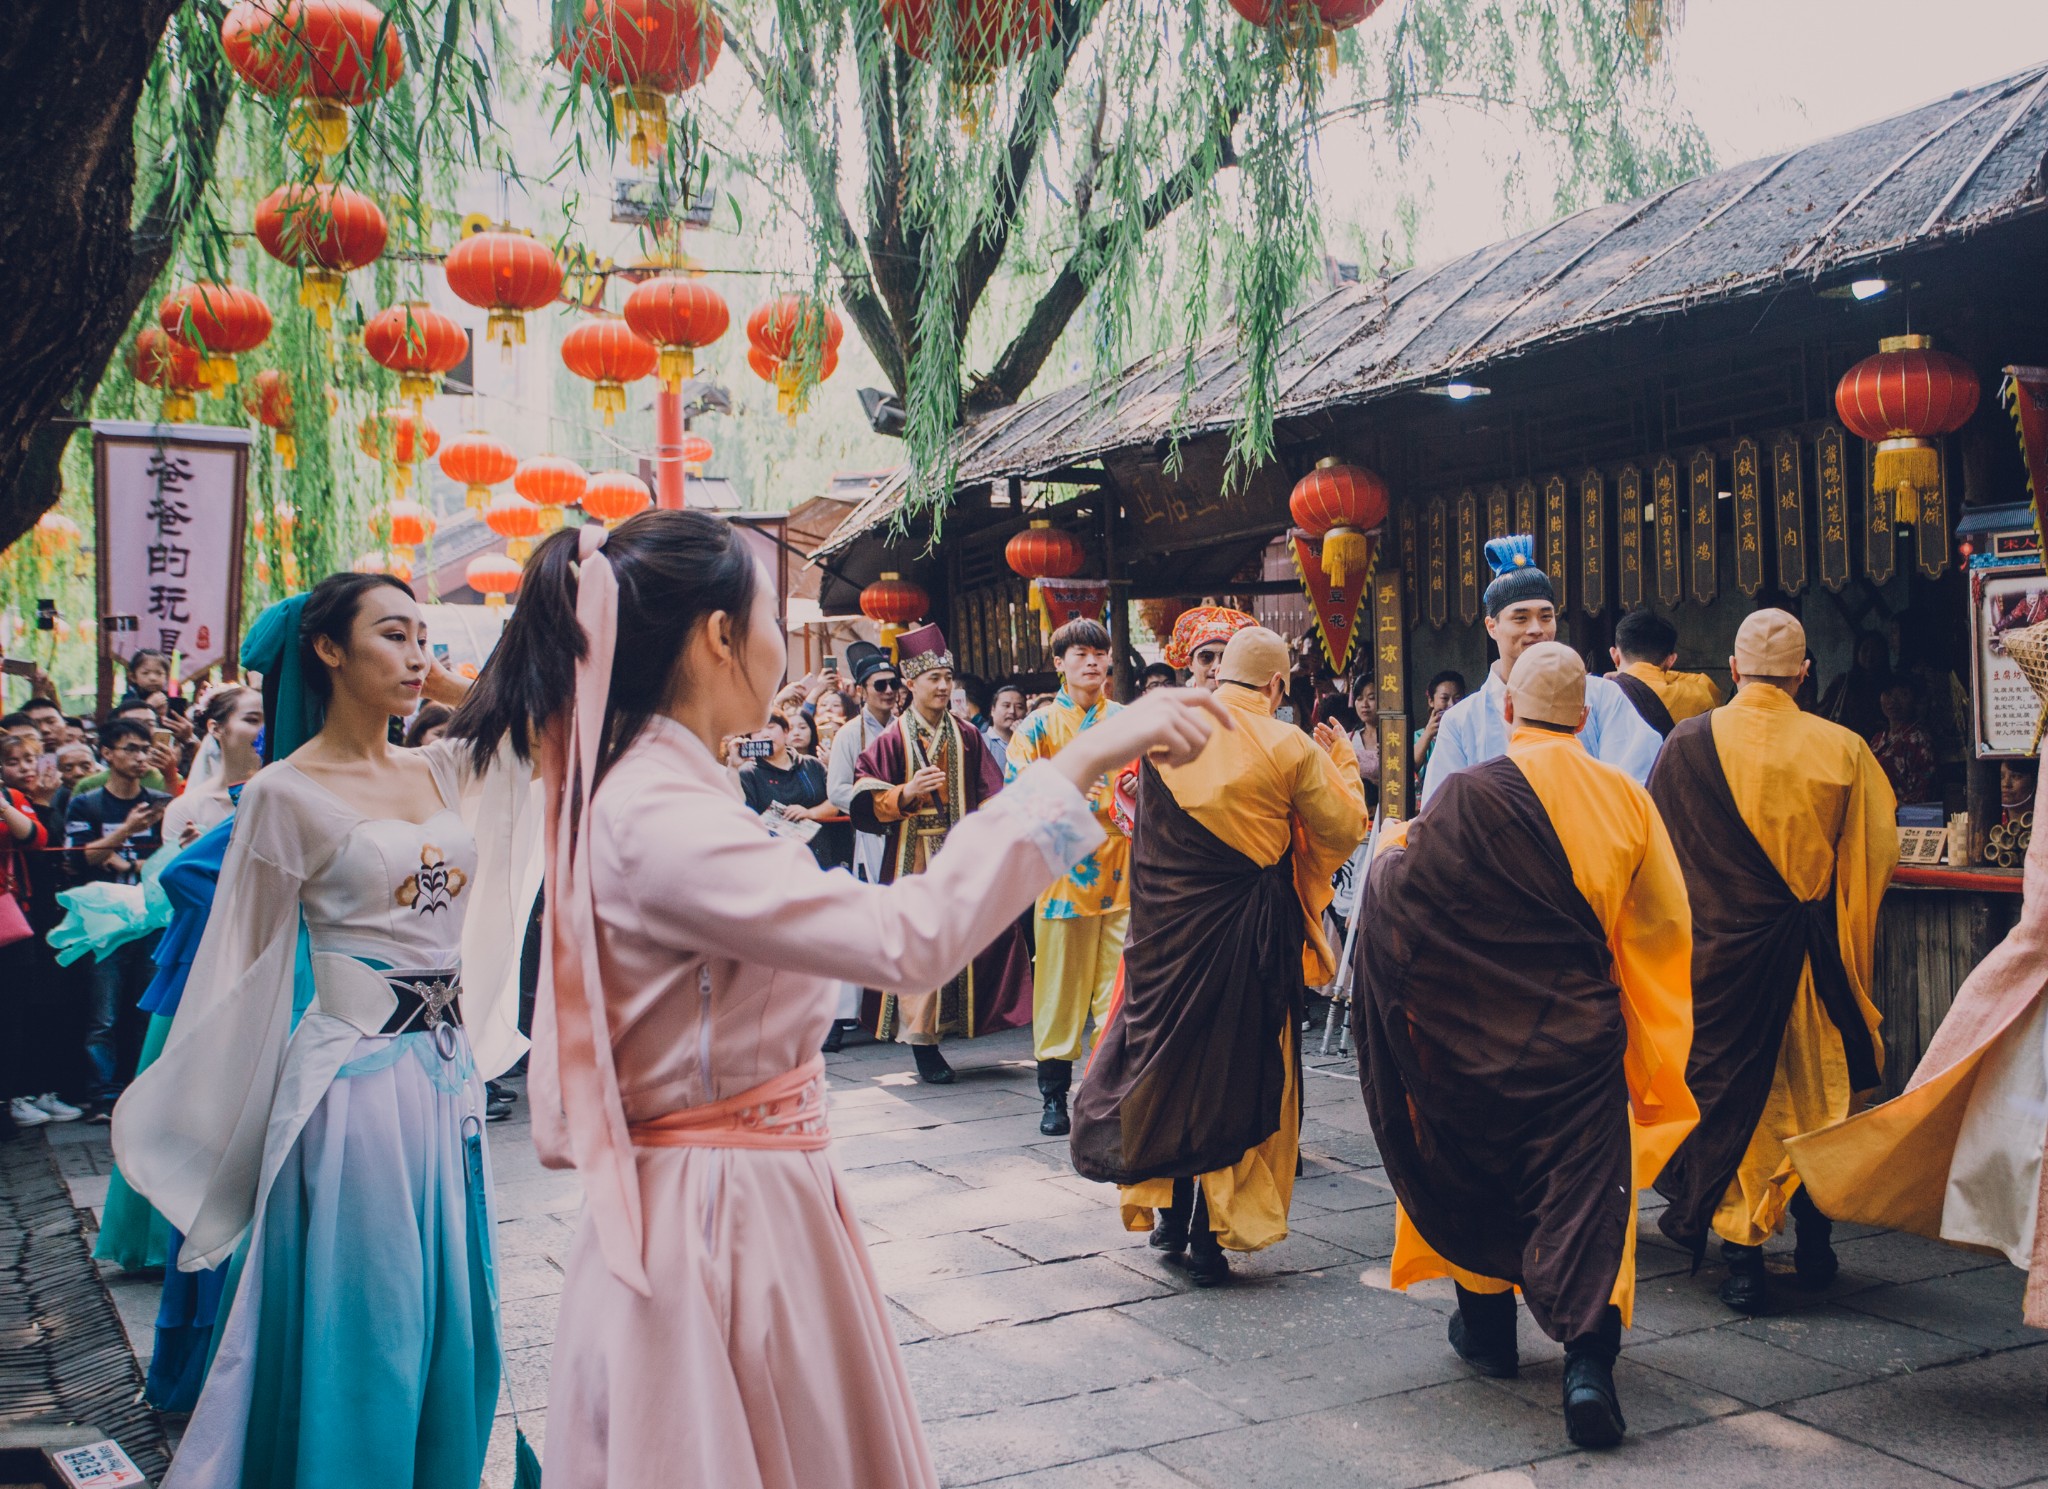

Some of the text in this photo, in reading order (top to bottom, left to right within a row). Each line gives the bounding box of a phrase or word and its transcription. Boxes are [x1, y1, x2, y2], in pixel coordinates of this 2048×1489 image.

[1493, 504, 1504, 538] 西安
[1586, 488, 1599, 575] 狼牙土豆
[1622, 485, 1637, 572] 西湖醋鱼
[1695, 469, 1711, 561] 叫花鸡
[1737, 458, 1756, 552] 铁板豆腐
[1780, 452, 1798, 546] 东坡肉
[1823, 445, 1843, 542] 酱鸭竹笼饭
[1871, 496, 1889, 534] 筒饭
[1923, 491, 1943, 526] 烧饼
[146, 455, 194, 662] 爸爸的玩具
[1432, 513, 1442, 591] 手工水饺
[1379, 585, 1399, 693] 手工凉皮
[1993, 670, 2022, 680] 豆腐坊
